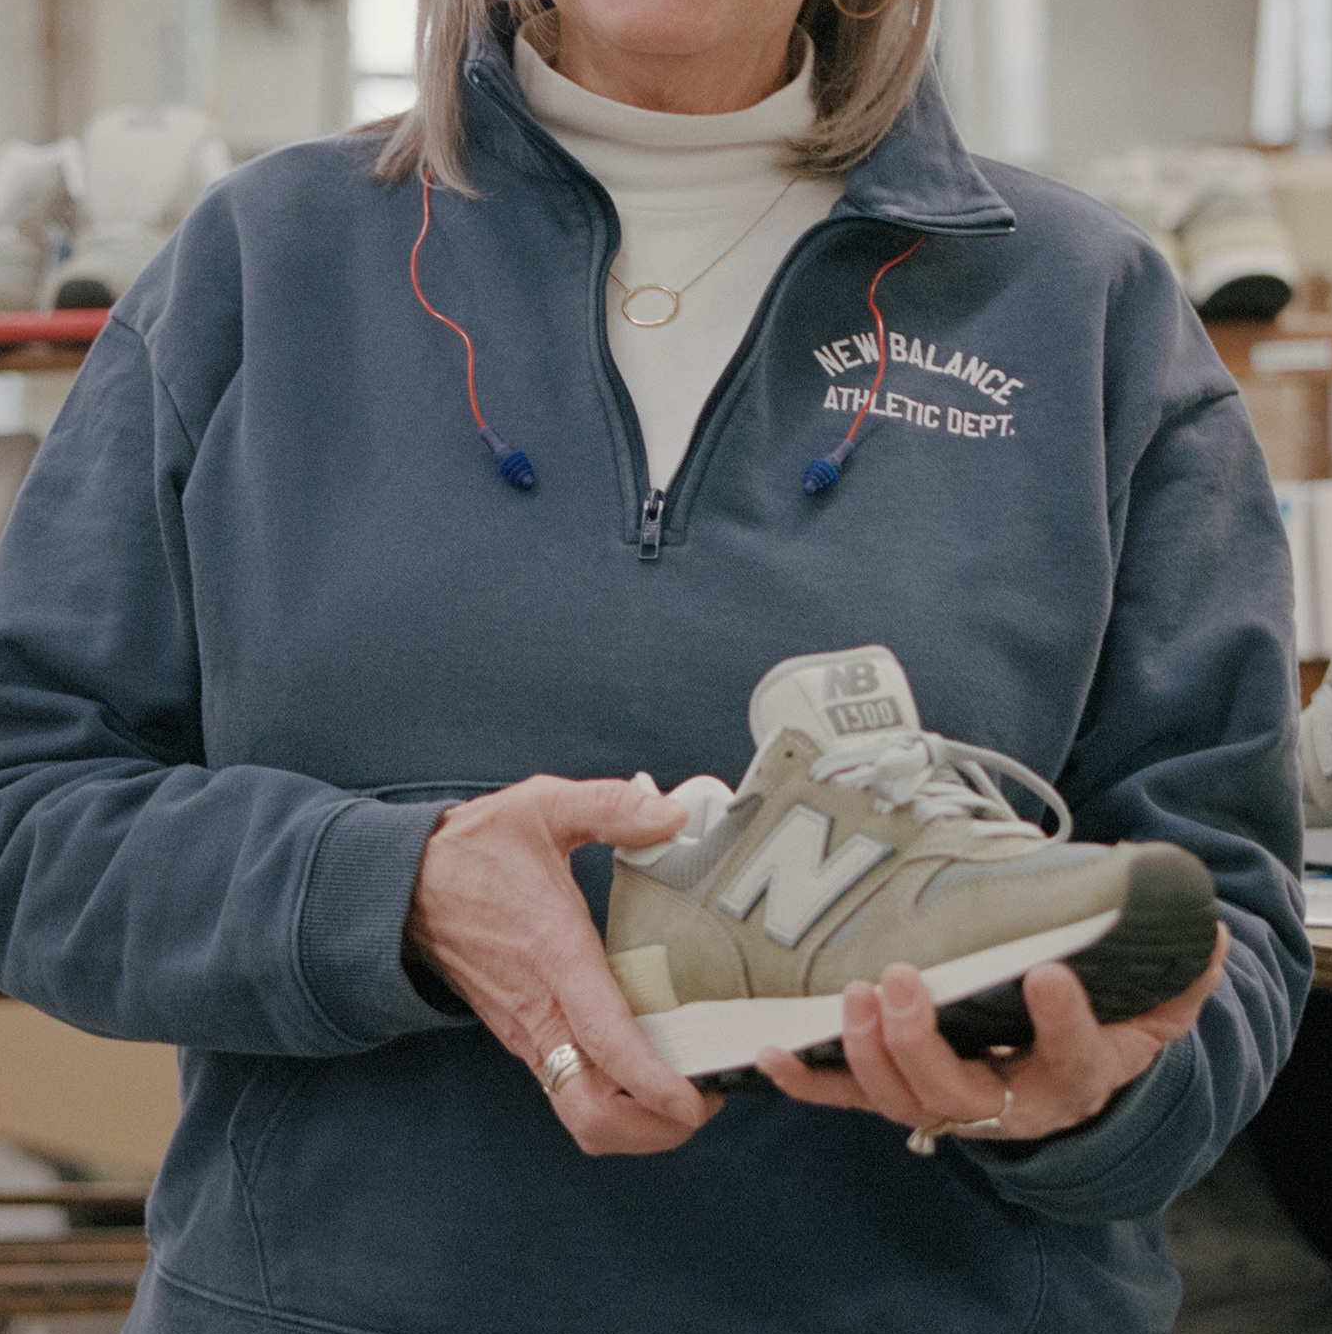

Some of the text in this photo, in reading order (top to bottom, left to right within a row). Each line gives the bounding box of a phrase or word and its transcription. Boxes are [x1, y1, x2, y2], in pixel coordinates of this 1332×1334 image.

[813, 331, 1025, 406] NEW BALANCE
[823, 385, 1016, 438] ATHLETIC DEPT.
[823, 662, 881, 700] NB
[834, 702, 897, 733] 1300
[719, 803, 894, 948] N
